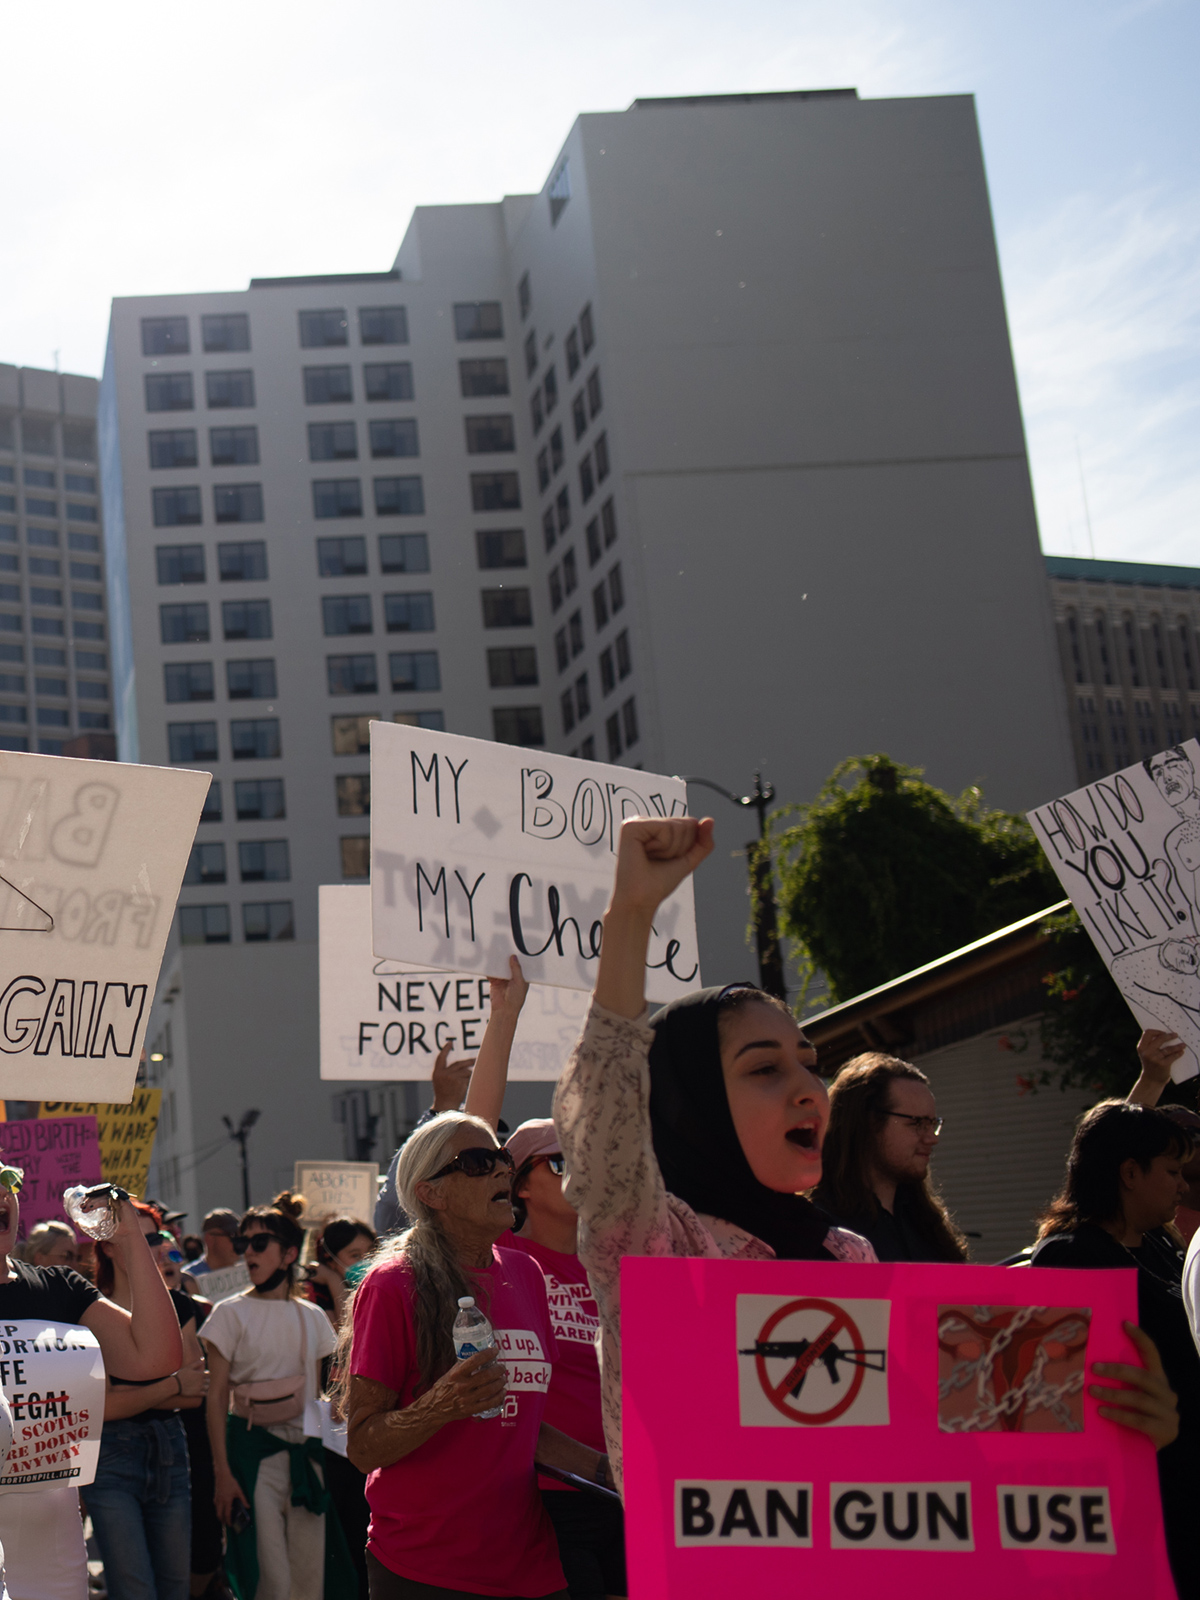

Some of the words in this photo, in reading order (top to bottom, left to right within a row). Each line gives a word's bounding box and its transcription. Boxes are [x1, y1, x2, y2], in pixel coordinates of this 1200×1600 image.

[410, 750, 468, 824] MY
[1035, 788, 1107, 860] HOW
[1095, 774, 1144, 831] DO
[1065, 831, 1150, 900] YOU
[416, 862, 485, 942] MY
[1084, 888, 1158, 957] LIKE
[359, 1020, 490, 1056] FORGE
[12, 1390, 72, 1422] EGAL
[22, 1409, 90, 1441] SCOTUS
[8, 1443, 82, 1475] ANYWAY
[35, 1425, 90, 1454] DOING
[1, 1468, 79, 1484] BORTIONPILL.INFO
[681, 1487, 810, 1539] BAN
[833, 1489, 971, 1542] GUN
[1003, 1493, 1109, 1545] USE
